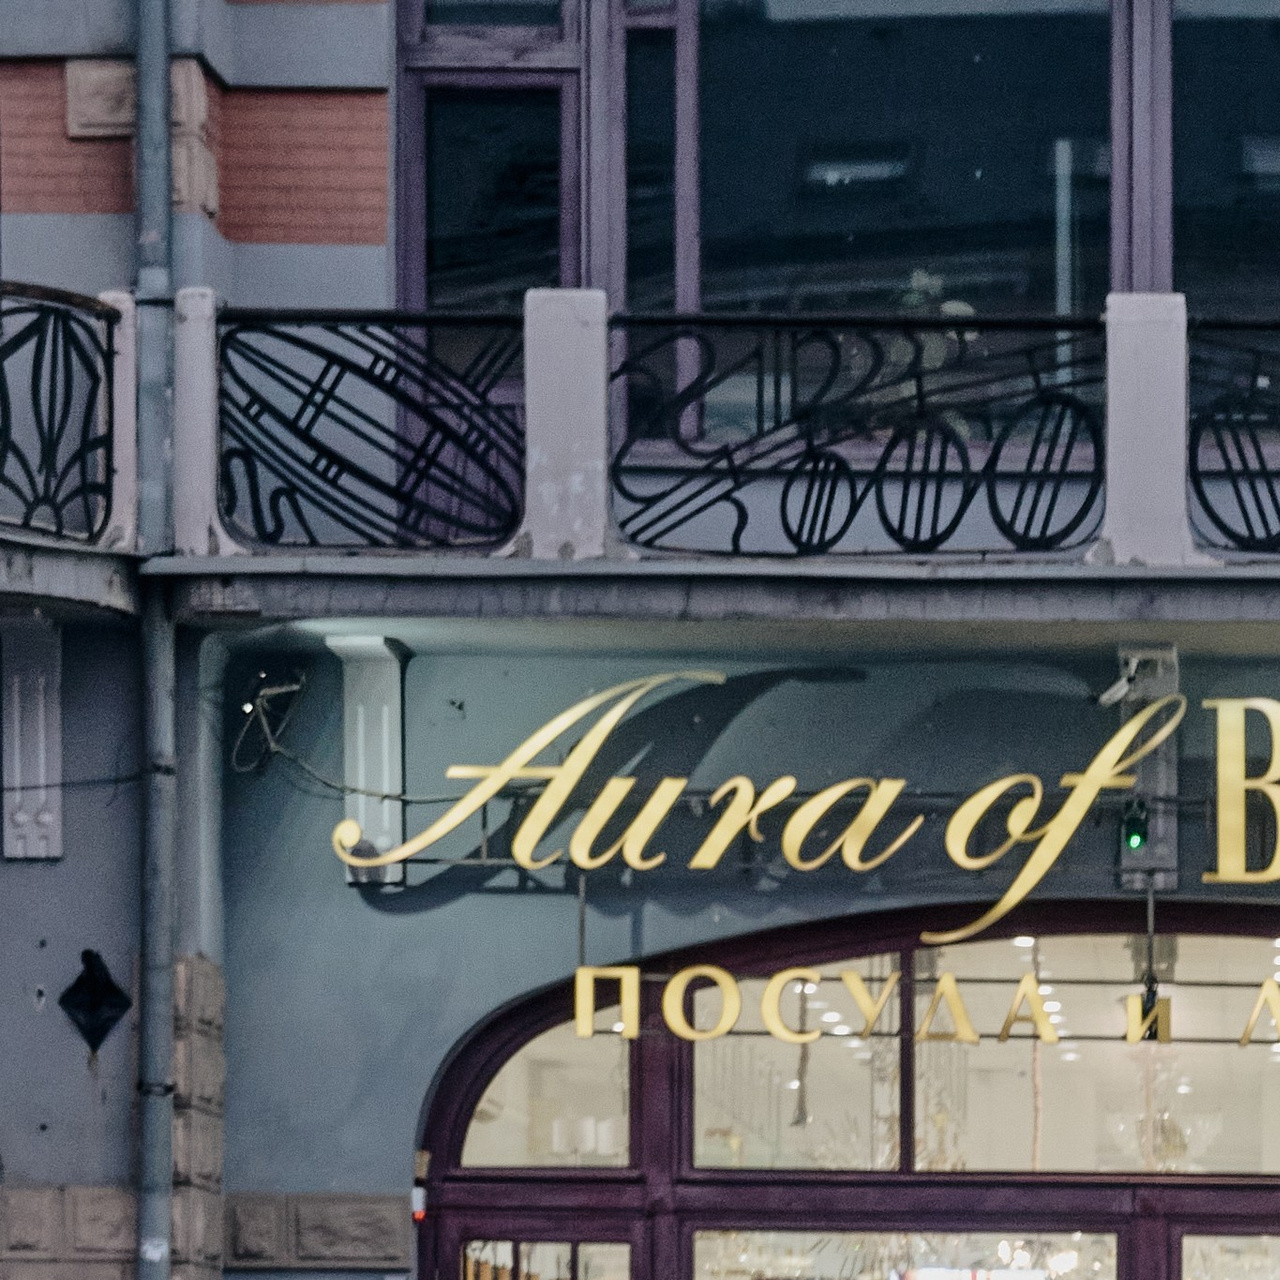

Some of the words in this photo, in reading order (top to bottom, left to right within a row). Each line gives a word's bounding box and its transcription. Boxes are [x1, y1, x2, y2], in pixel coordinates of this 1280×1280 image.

[333, 669, 925, 871] Aura
[919, 691, 1186, 943] of
[575, 964, 1061, 1045] ПОСУДА
